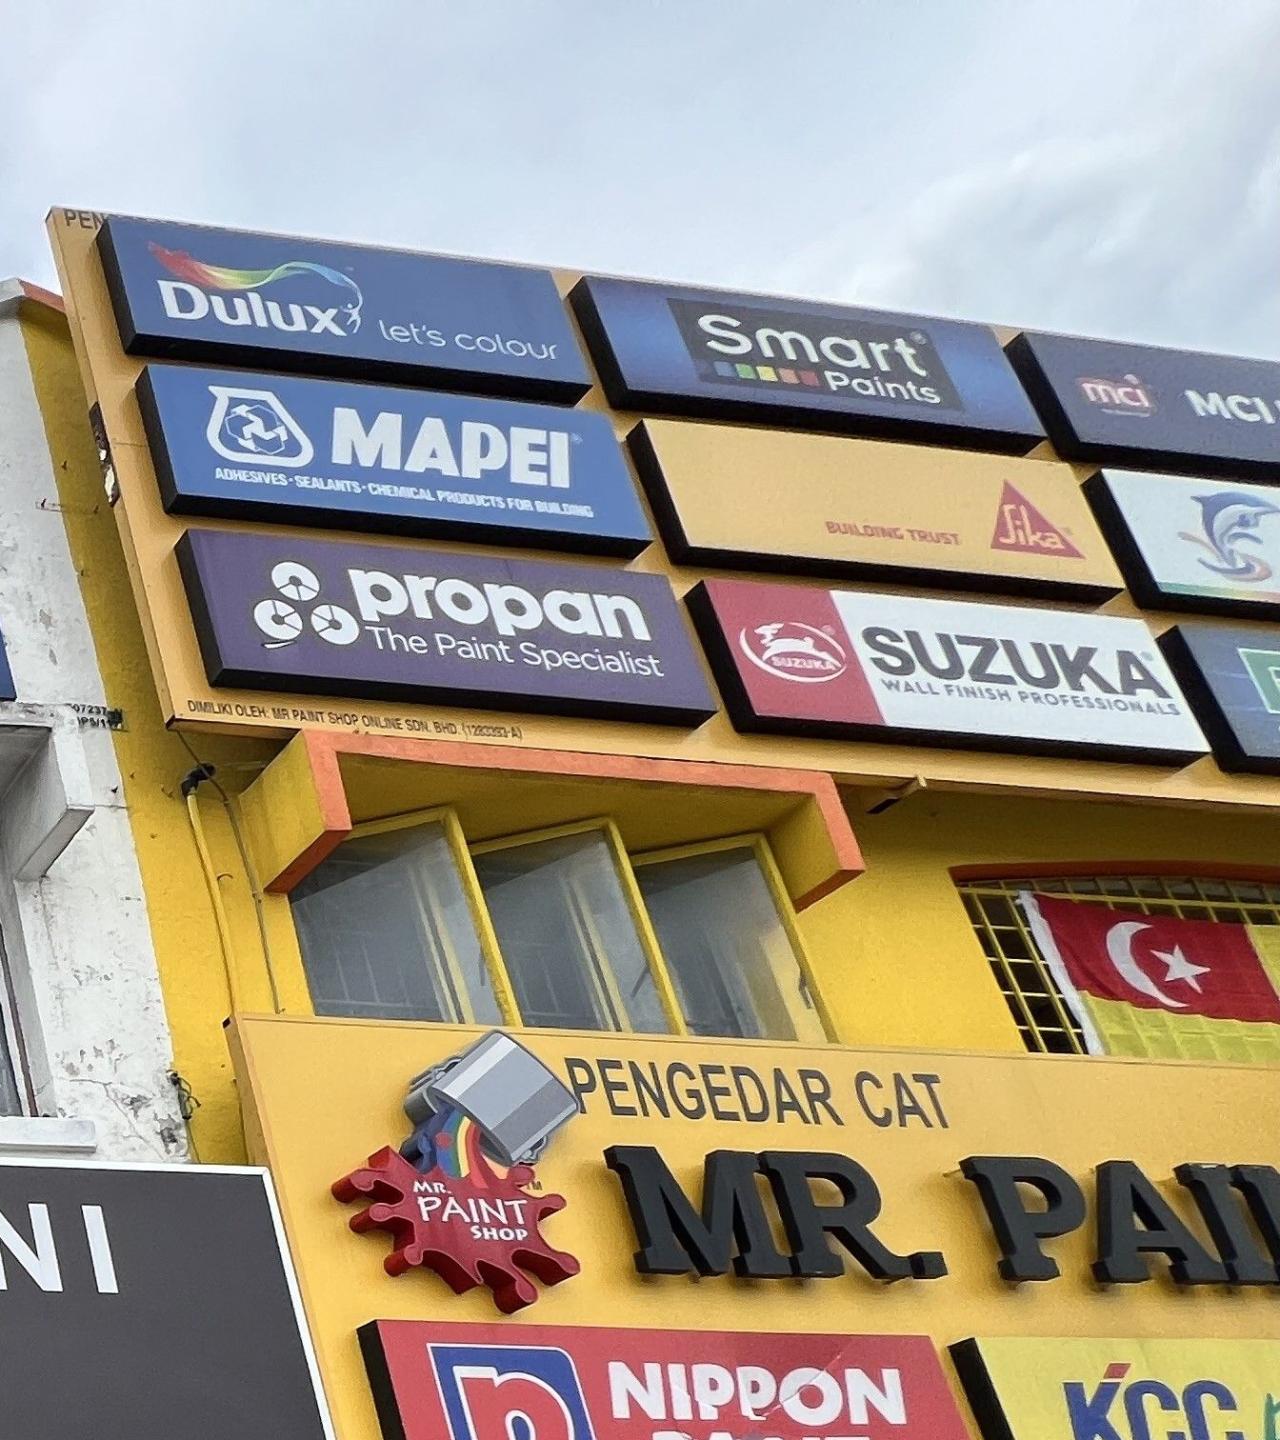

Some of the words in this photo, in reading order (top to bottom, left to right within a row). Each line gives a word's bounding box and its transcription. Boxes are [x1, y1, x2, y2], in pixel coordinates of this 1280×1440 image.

[157, 279, 346, 336] Dulux
[378, 319, 446, 348] let's
[455, 327, 558, 361] colour
[697, 312, 928, 377] Smart
[825, 368, 941, 405] Paints
[1081, 374, 1153, 409] mci
[332, 407, 571, 489] MAPEI
[215, 467, 287, 486] ADHESIVES
[295, 475, 361, 494] SEALANTS
[368, 483, 436, 502] CHEMICAL
[436, 491, 504, 509] PRODUCTS
[507, 497, 533, 512] FOR
[535, 500, 594, 518] BUILDING
[826, 521, 904, 541] BUILDING
[907, 528, 960, 546] TRUST
[1000, 503, 1065, 549] Sika
[347, 569, 652, 642] propan
[365, 624, 428, 656] The
[439, 632, 511, 665] Paint
[520, 640, 665, 679] Specialist
[772, 656, 836, 671] SUZUKA
[860, 624, 1173, 699] SUZUKA
[188, 700, 232, 716] DIMILIKI
[235, 705, 268, 719] OLEH:
[272, 707, 290, 721] MR
[292, 709, 324, 724] PAINT
[329, 711, 358, 727] SHOP
[362, 715, 403, 731] ONLINE
[405, 718, 432, 733] SDN.
[433, 720, 460, 735] BHD.
[881, 679, 939, 695] WALL
[944, 684, 1011, 701] FINISH
[1019, 690, 1181, 716] PROFESSIONALS
[565, 1057, 844, 1127] PENGEDAR
[856, 1071, 950, 1129] CAT
[413, 1180, 450, 1195] MR.
[417, 1196, 527, 1224] PAINT
[470, 1224, 528, 1242] SHOP
[604, 1145, 947, 1281] MR.
[608, 1361, 907, 1427] NIPPON
